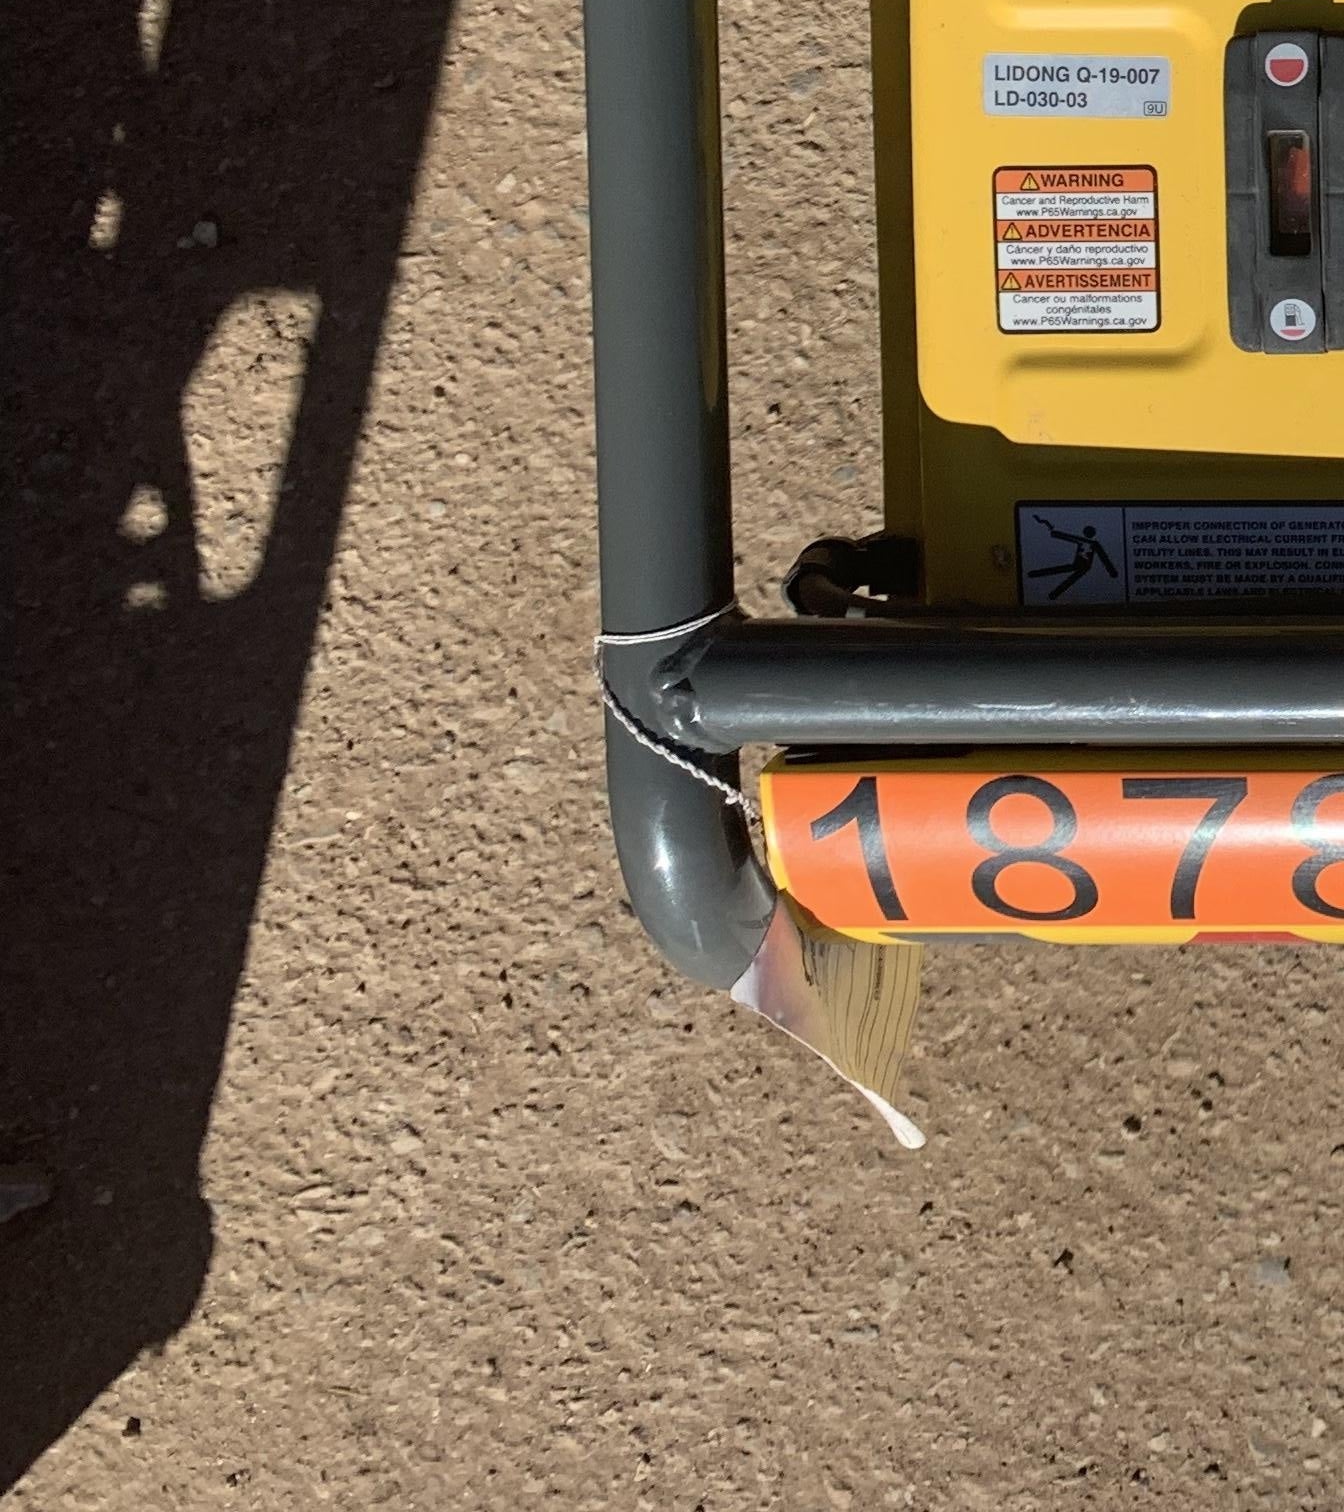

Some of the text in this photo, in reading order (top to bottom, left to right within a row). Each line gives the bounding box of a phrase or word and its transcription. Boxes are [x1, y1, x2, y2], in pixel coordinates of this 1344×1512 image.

[994, 66, 1161, 83] LIDONG Q-19-007
[994, 91, 1088, 106] LD-030-03
[1041, 174, 1124, 188] WARNING
[1001, 196, 1150, 208] Cancer and Reproductive Harm
[1015, 207, 1138, 218] www.P65Warnings.ca.gov
[1025, 223, 1151, 238] ADVERTENCIA
[1006, 245, 1149, 257] Cáncer y daño reproductivo
[1010, 256, 1146, 267] www.P65Warnings.ca.gov
[1024, 273, 1152, 288] AVERTISSEMENT
[1012, 294, 1143, 304] Cancer ou malformations
[1045, 305, 1112, 317] congénitales
[1013, 316, 1148, 328] www.P65Warnings.ca.gov
